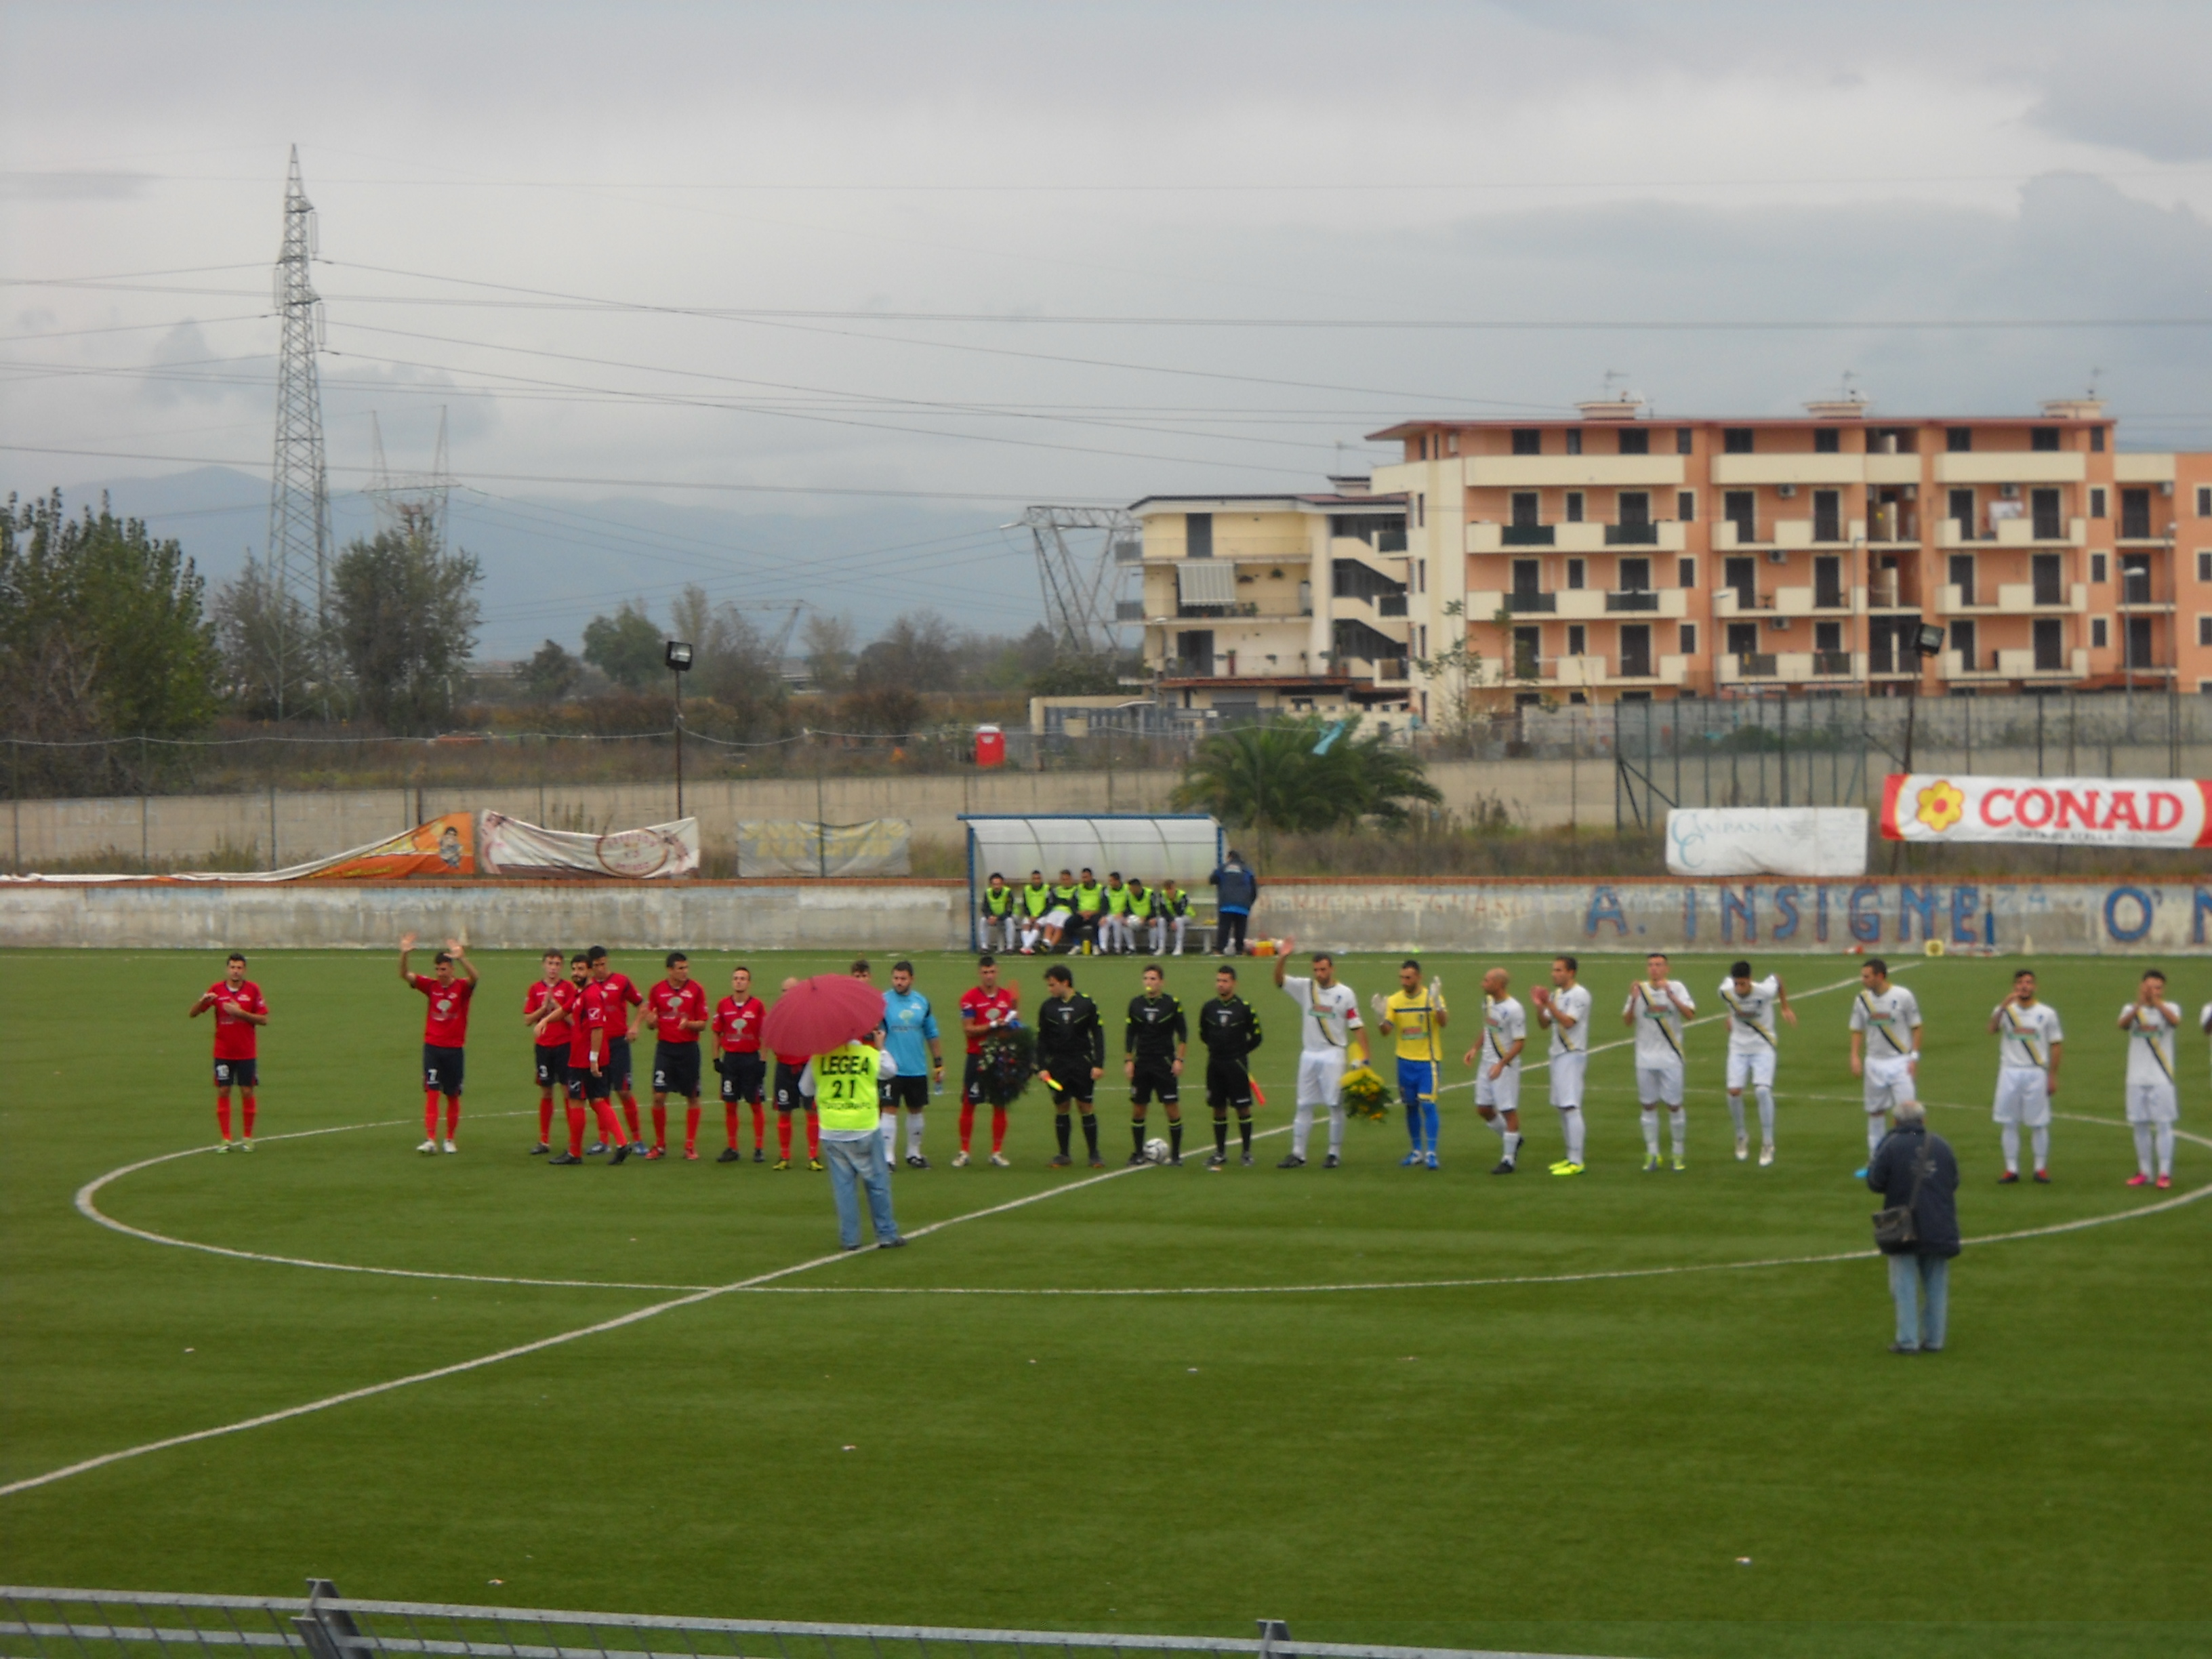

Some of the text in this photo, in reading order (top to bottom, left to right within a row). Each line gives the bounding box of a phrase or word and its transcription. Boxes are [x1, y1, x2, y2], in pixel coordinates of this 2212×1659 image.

[1979, 787, 2184, 832] CONAD
[1684, 883, 1980, 946] INSIGNE
[820, 1055, 869, 1076] LEGEA
[655, 1070, 665, 1083] 2
[724, 1080, 733, 1092] 8
[832, 1079, 855, 1099] 21
[884, 1084, 892, 1097] 1
[778, 1089, 789, 1102] 9
